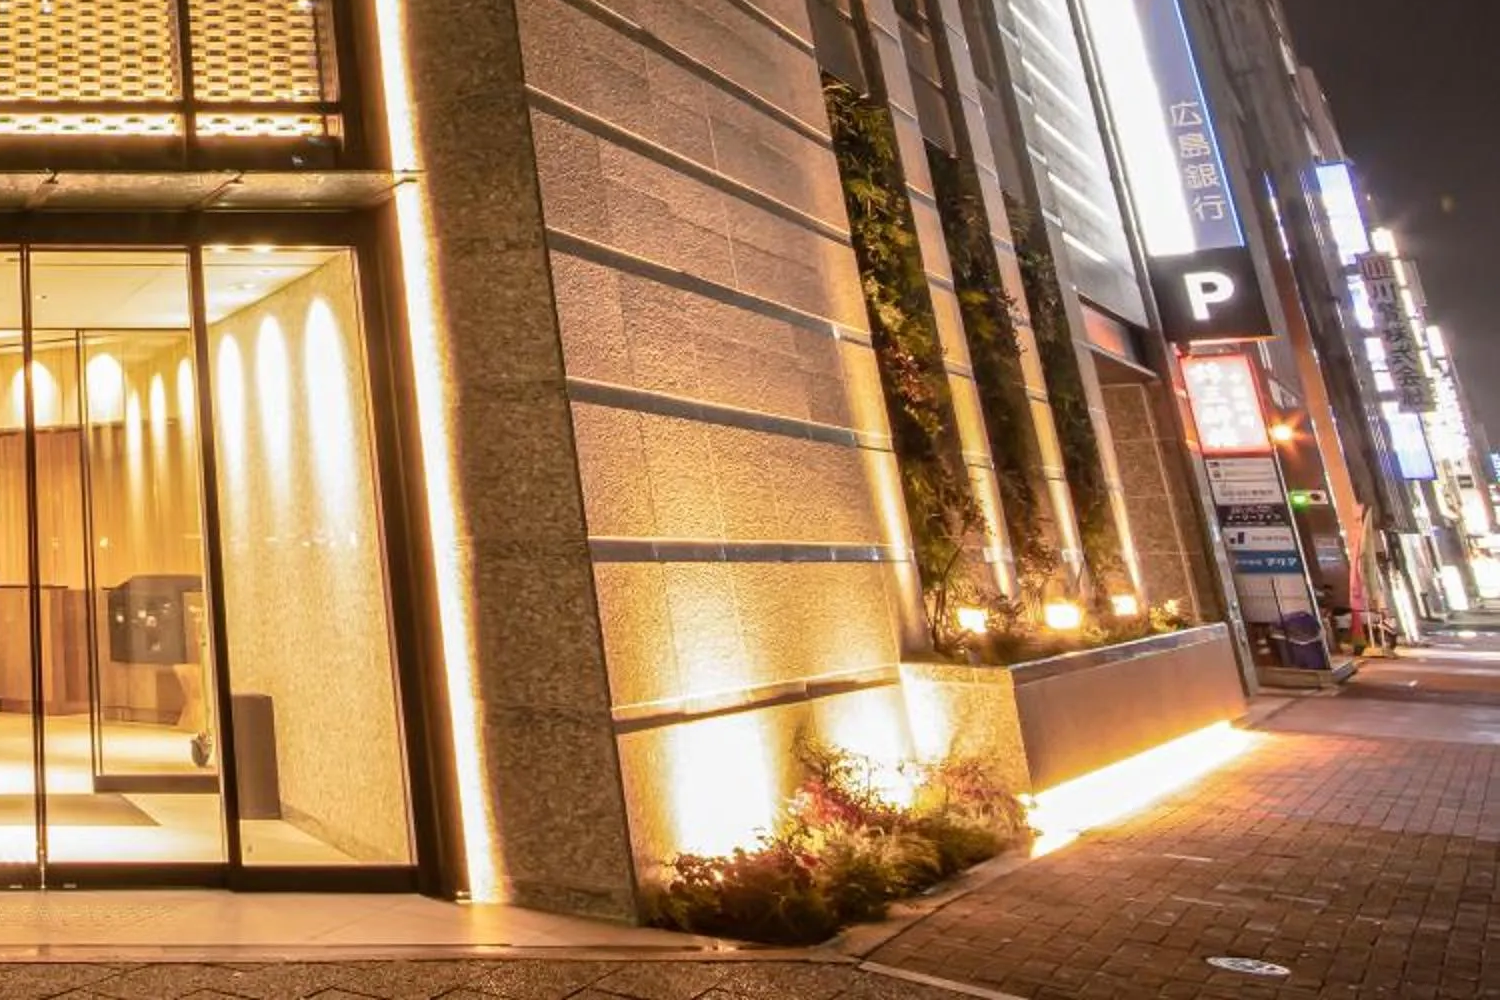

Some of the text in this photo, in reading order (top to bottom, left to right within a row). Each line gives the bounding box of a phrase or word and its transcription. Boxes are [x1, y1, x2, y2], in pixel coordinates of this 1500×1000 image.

[1169, 100, 1226, 222] 広島銀行
[1183, 271, 1236, 321] P
